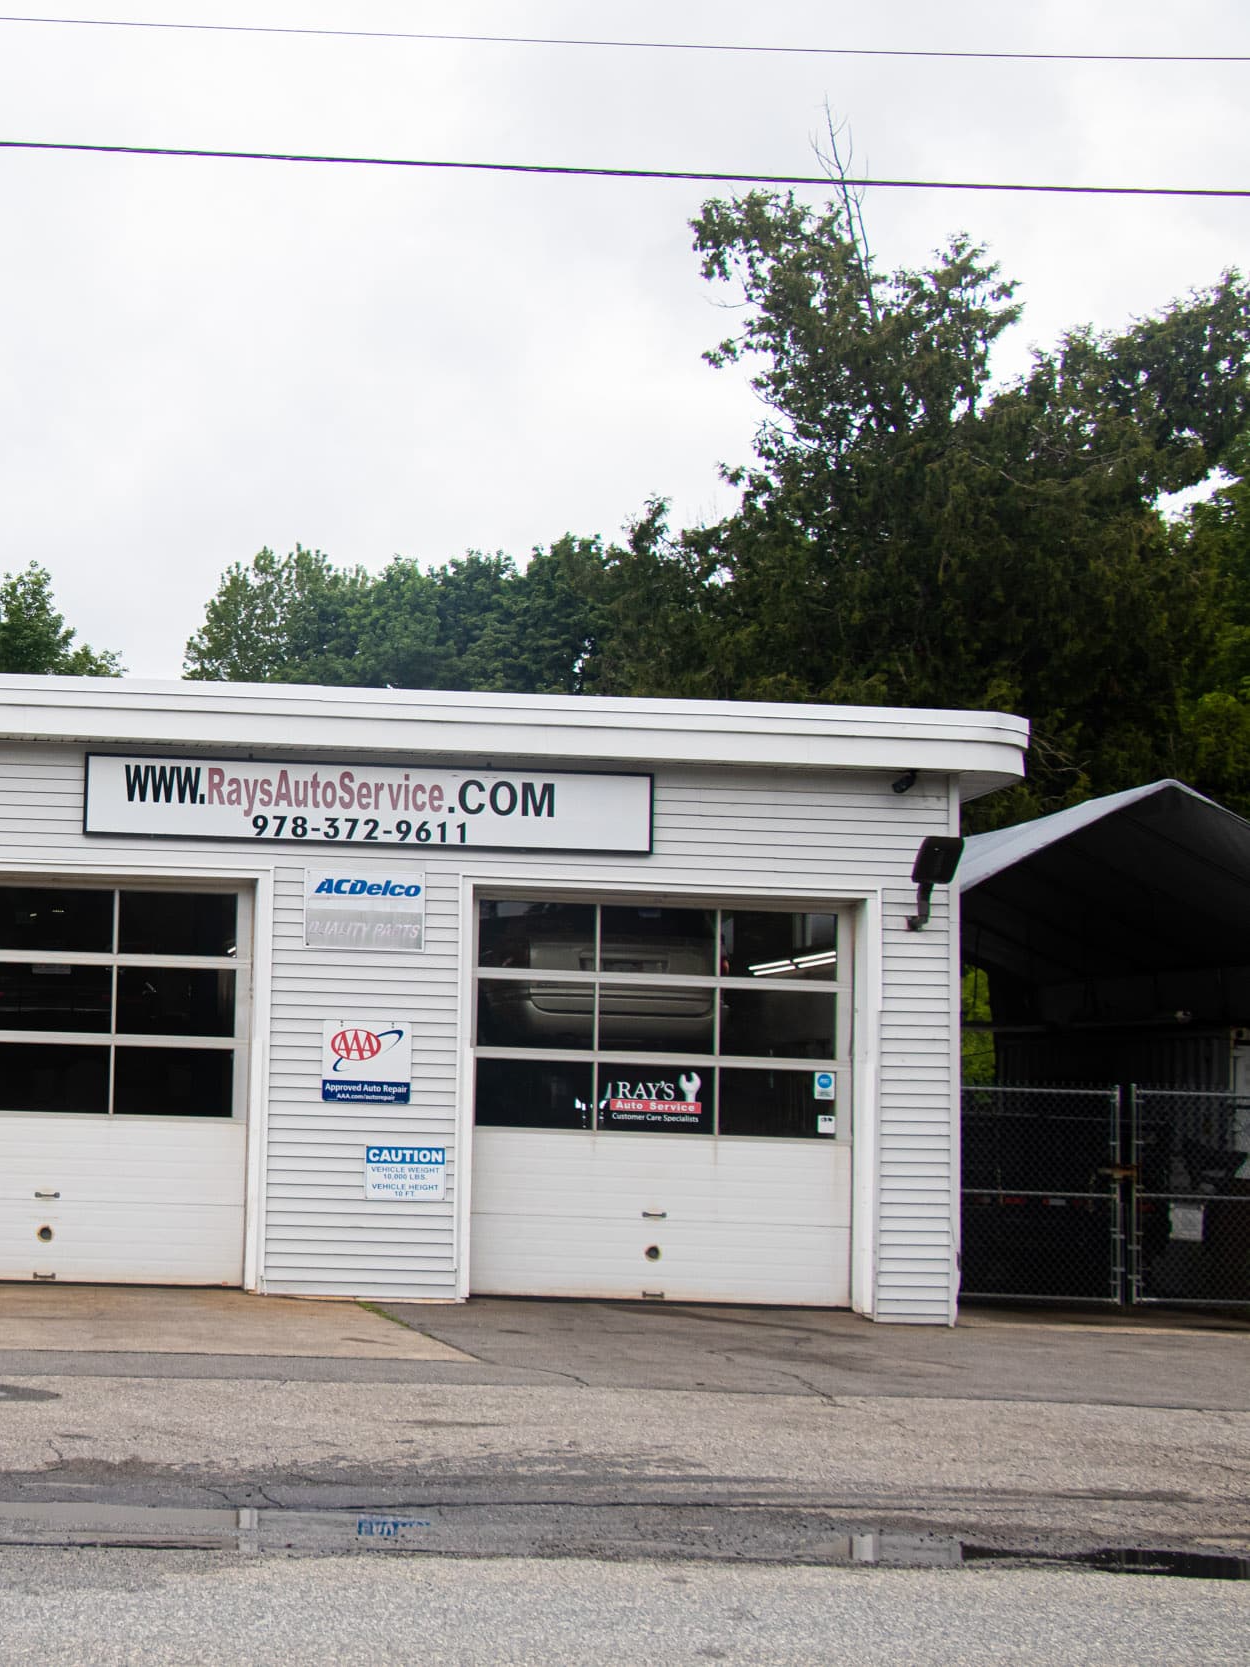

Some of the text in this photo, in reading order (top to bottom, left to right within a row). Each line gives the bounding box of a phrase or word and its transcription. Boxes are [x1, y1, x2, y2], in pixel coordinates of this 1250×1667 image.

[125, 764, 556, 817] WWW.RaysAutoService.COM
[251, 814, 468, 844] 978-372-9611
[315, 878, 421, 897] ACDelco
[336, 1030, 378, 1060] AAA
[325, 1082, 408, 1095] Approved Auto Repair
[616, 1080, 675, 1101] RAY'S
[615, 1100, 696, 1112] Auto Service
[612, 1112, 645, 1120] Customer
[663, 1114, 699, 1123] Specialists
[368, 1149, 443, 1163] CAUTION
